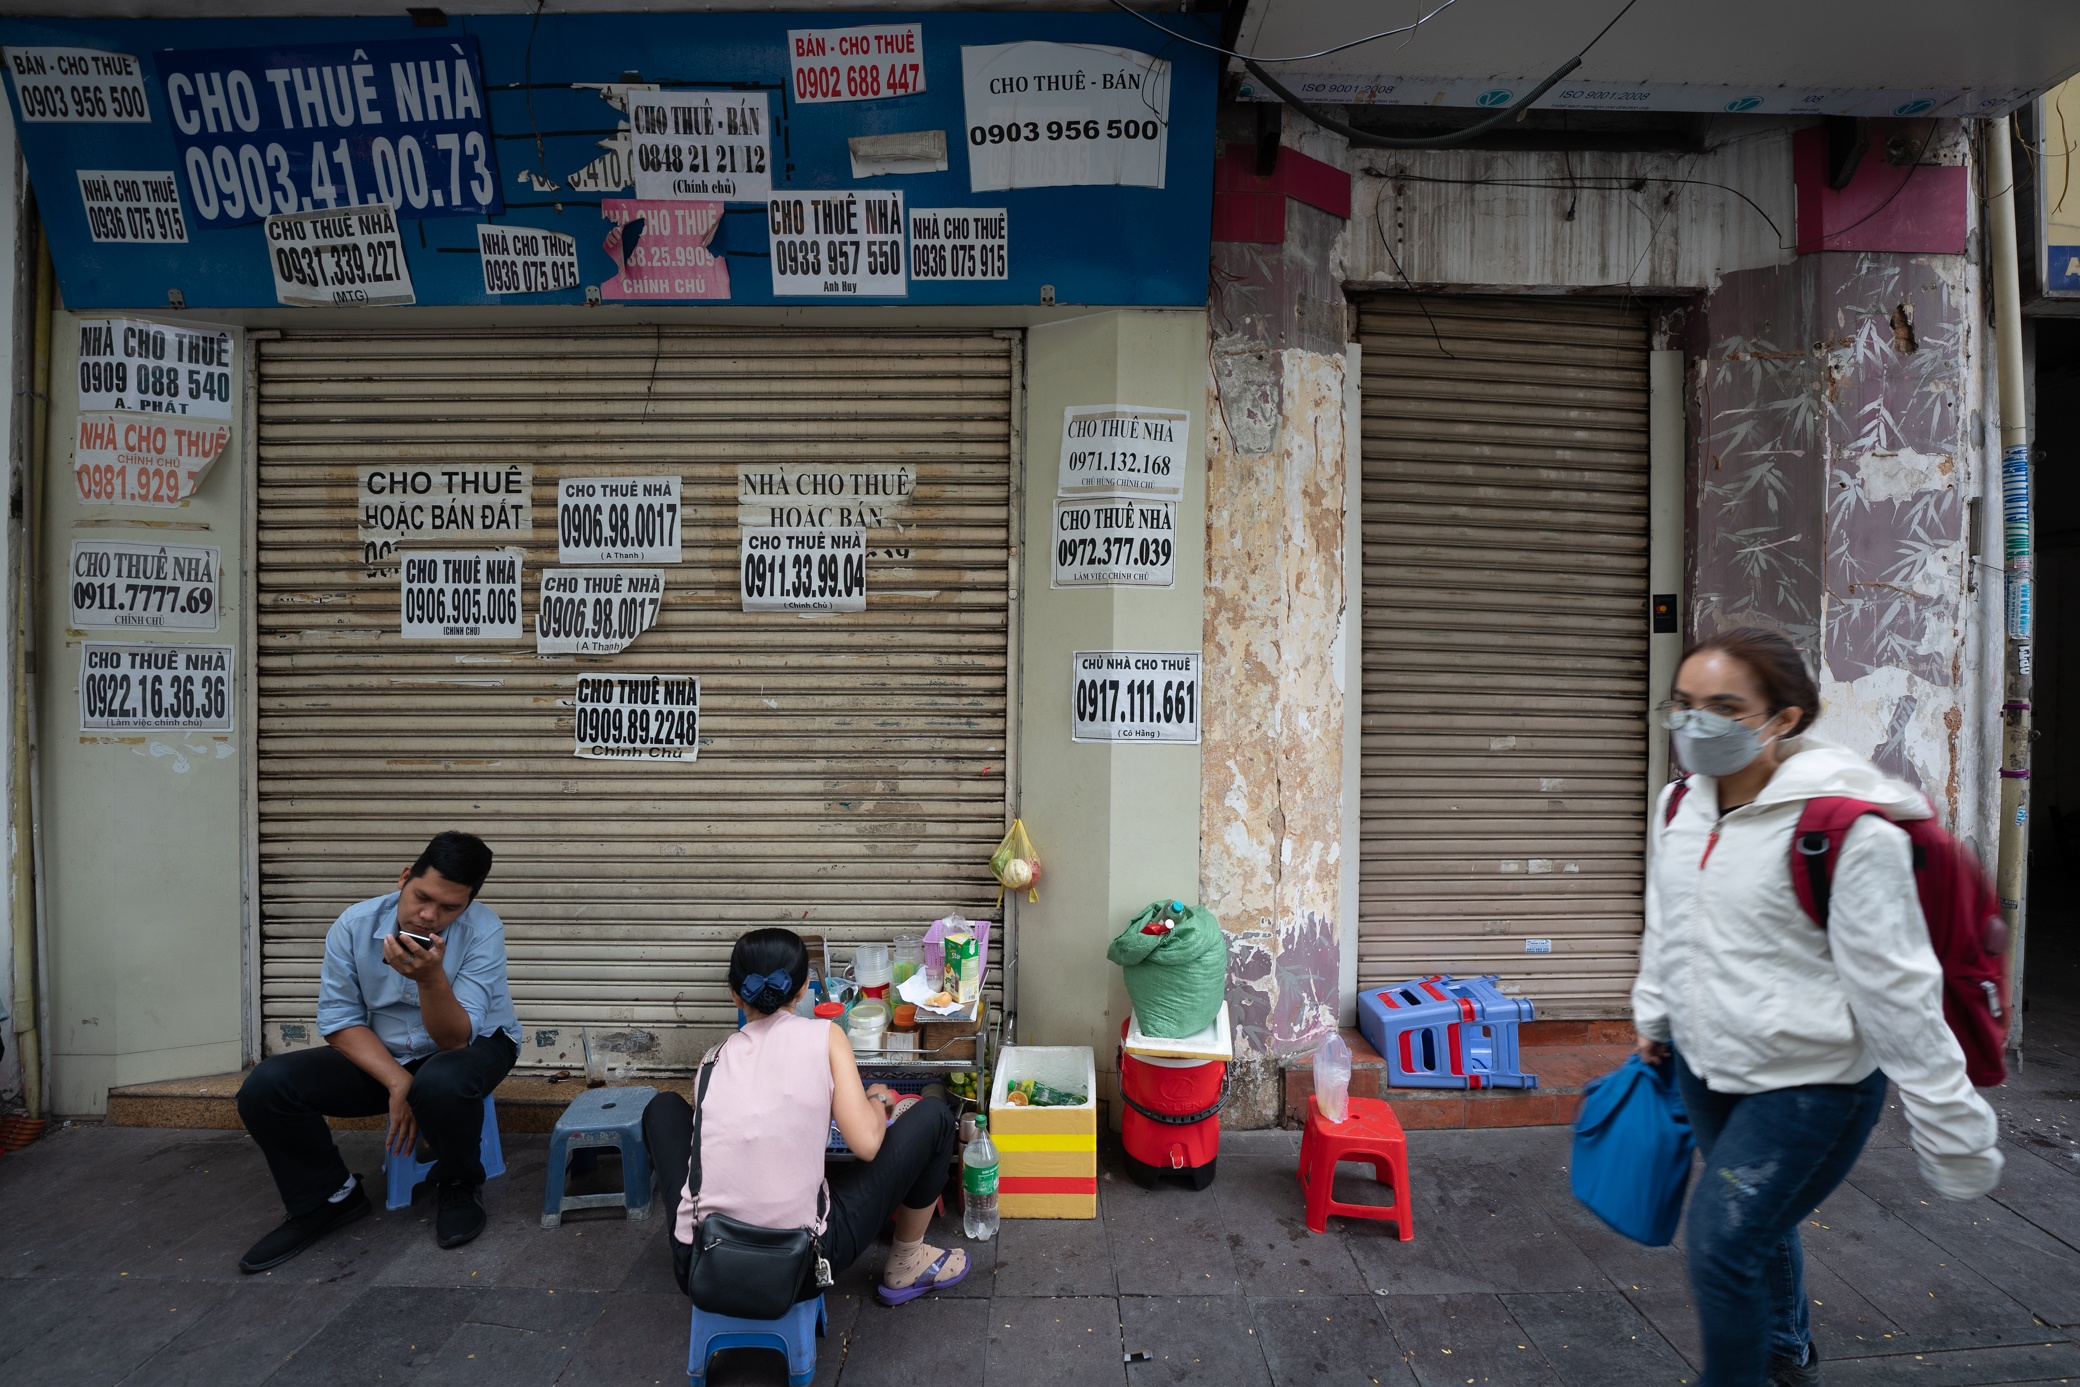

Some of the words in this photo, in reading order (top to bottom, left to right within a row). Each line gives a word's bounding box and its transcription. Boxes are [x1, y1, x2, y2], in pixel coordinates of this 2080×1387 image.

[796, 32, 826, 58] BÁN
[839, 34, 870, 57] CHO
[873, 29, 916, 55] THUÊ
[13, 51, 47, 76] BÁN
[57, 57, 89, 76] CHO
[167, 70, 260, 135] CHO
[265, 49, 383, 130] THUÊ
[391, 43, 481, 123] NHÀ
[796, 66, 841, 99] 0902
[846, 64, 881, 97] 688
[886, 63, 920, 95] 447
[990, 76, 1031, 95] CHO
[1034, 70, 1088, 93] THUÊ
[1102, 68, 1142, 91] BÁN
[1301, 83, 1326, 92] ISO
[1558, 90, 1584, 99] ISO
[1585, 90, 1651, 101] 9001:2008
[21, 85, 69, 118] 0903
[70, 85, 107, 118] 956
[110, 86, 145, 118] 500
[634, 105, 667, 137] CHO
[670, 98, 714, 137] THUÊ
[726, 101, 761, 137] BÁN
[970, 120, 1040, 147] 0903
[1047, 119, 1100, 141] 956
[1106, 119, 1159, 142] 500
[638, 143, 683, 174] 0848
[688, 144, 710, 174] 21
[716, 144, 737, 174] 21
[744, 144, 766, 175] 12
[82, 175, 111, 202] NHÀ
[114, 180, 141, 202] CHO
[142, 176, 178, 203] THUÊ
[186, 131, 493, 220] 0903.41.00.73
[673, 179, 707, 196] (Chính
[710, 180, 737, 198] chủ)
[89, 206, 123, 239] 0936
[126, 206, 155, 240] 075
[159, 207, 184, 240] 915
[268, 220, 306, 241] CHO
[310, 216, 352, 239] THUÊ
[356, 209, 396, 236] NHÀ
[636, 208, 671, 237] CHO
[770, 197, 805, 237] CHO
[810, 192, 858, 236] THUÊ
[865, 191, 902, 236] NHÀ
[913, 213, 940, 240] NHÀ
[943, 218, 971, 240] CHO
[973, 212, 1006, 240] THUÊ
[481, 229, 510, 256] NHÀ
[513, 235, 539, 257] CHO
[276, 240, 401, 287] 0931.339.227
[776, 239, 820, 277] 0933
[827, 239, 860, 276] 957
[867, 239, 900, 276] 550
[913, 244, 946, 278] 0936
[951, 244, 976, 278] 075
[980, 244, 1005, 278] 915
[485, 260, 518, 292] 0936
[522, 261, 548, 292] 075
[551, 261, 578, 290] 915
[622, 275, 670, 294] CHÍNH
[675, 274, 706, 294] CHỦ
[823, 280, 839, 294] Anh
[841, 280, 858, 295] Huy
[333, 289, 369, 306] (MTG)
[80, 320, 114, 357] NHÀ
[123, 327, 166, 361] CHO
[174, 332, 230, 368] THUÊ
[80, 361, 127, 393] 0909
[136, 364, 179, 398] 088
[188, 369, 230, 402] 540
[140, 399, 189, 415] PHÁT
[80, 415, 117, 450] NHÀ
[124, 424, 167, 455] CHO
[174, 426, 227, 462] THUÊ
[1068, 420, 1097, 439] CHO
[1101, 416, 1139, 440] THUÊ
[1142, 421, 1173, 444] NHÀ
[117, 450, 153, 466] CHÍNH
[1069, 451, 1171, 476] 0971.132.168
[367, 470, 432, 495] CHO
[441, 465, 523, 495] THUÊ
[565, 484, 596, 498] CHO
[600, 480, 638, 498] THUÊ
[642, 480, 672, 498] NHÀ
[742, 466, 790, 496] NHÀ
[796, 473, 844, 496] CHO
[850, 466, 909, 496] THUÊ
[365, 500, 424, 537] HOẶC
[431, 498, 474, 530] BÁN
[480, 498, 523, 531] ĐẤT
[561, 502, 677, 549] 0906.98.0017
[839, 501, 883, 528] BÁN
[1060, 508, 1090, 531] CHO
[1094, 501, 1134, 530] THUÊ
[1138, 503, 1172, 530] NHÀ
[748, 535, 781, 550] CHO
[785, 531, 826, 550] THUÊ
[831, 531, 861, 550] NHÀ
[1058, 537, 1172, 566] 0972.377.039
[75, 551, 110, 579] CHO
[114, 547, 168, 581] THUÊ
[172, 551, 214, 583] NHÀ
[406, 559, 436, 584] CHO
[442, 556, 482, 584] THUÊ
[486, 556, 516, 584] NHÀ
[614, 552, 638, 560] Thanh
[544, 577, 578, 593] CHO
[583, 574, 623, 594] THUÊ
[627, 573, 660, 594] NHÀ
[745, 553, 865, 598] 0911.33.99.04
[1090, 571, 1107, 582] VIỆC
[1107, 571, 1132, 581] CHÍNH
[73, 581, 213, 614] 0911.7777.69
[406, 588, 516, 625] 0906.905.006
[789, 601, 811, 609] Chính
[114, 613, 144, 626] CHÍNH
[540, 596, 659, 639] 0906.98.0017
[88, 652, 121, 669] CHO
[128, 650, 178, 670] THUÊ
[185, 651, 225, 671] NHÀ
[1082, 655, 1103, 670] CHỦ
[1106, 656, 1131, 670] NHÀ
[1134, 659, 1158, 671] CHO
[1161, 656, 1191, 671] THUÊ
[86, 673, 225, 719] 0922.16.36.36
[578, 678, 613, 704] CHO
[618, 675, 659, 705] THUÊ
[664, 676, 697, 706] NHÀ
[1076, 678, 1195, 723] 0917.111.661
[133, 718, 154, 728] việc
[155, 718, 180, 727] chính
[577, 707, 697, 746] 0909.89.2248
[591, 745, 643, 757] Chính
[648, 746, 682, 759] Chủ
